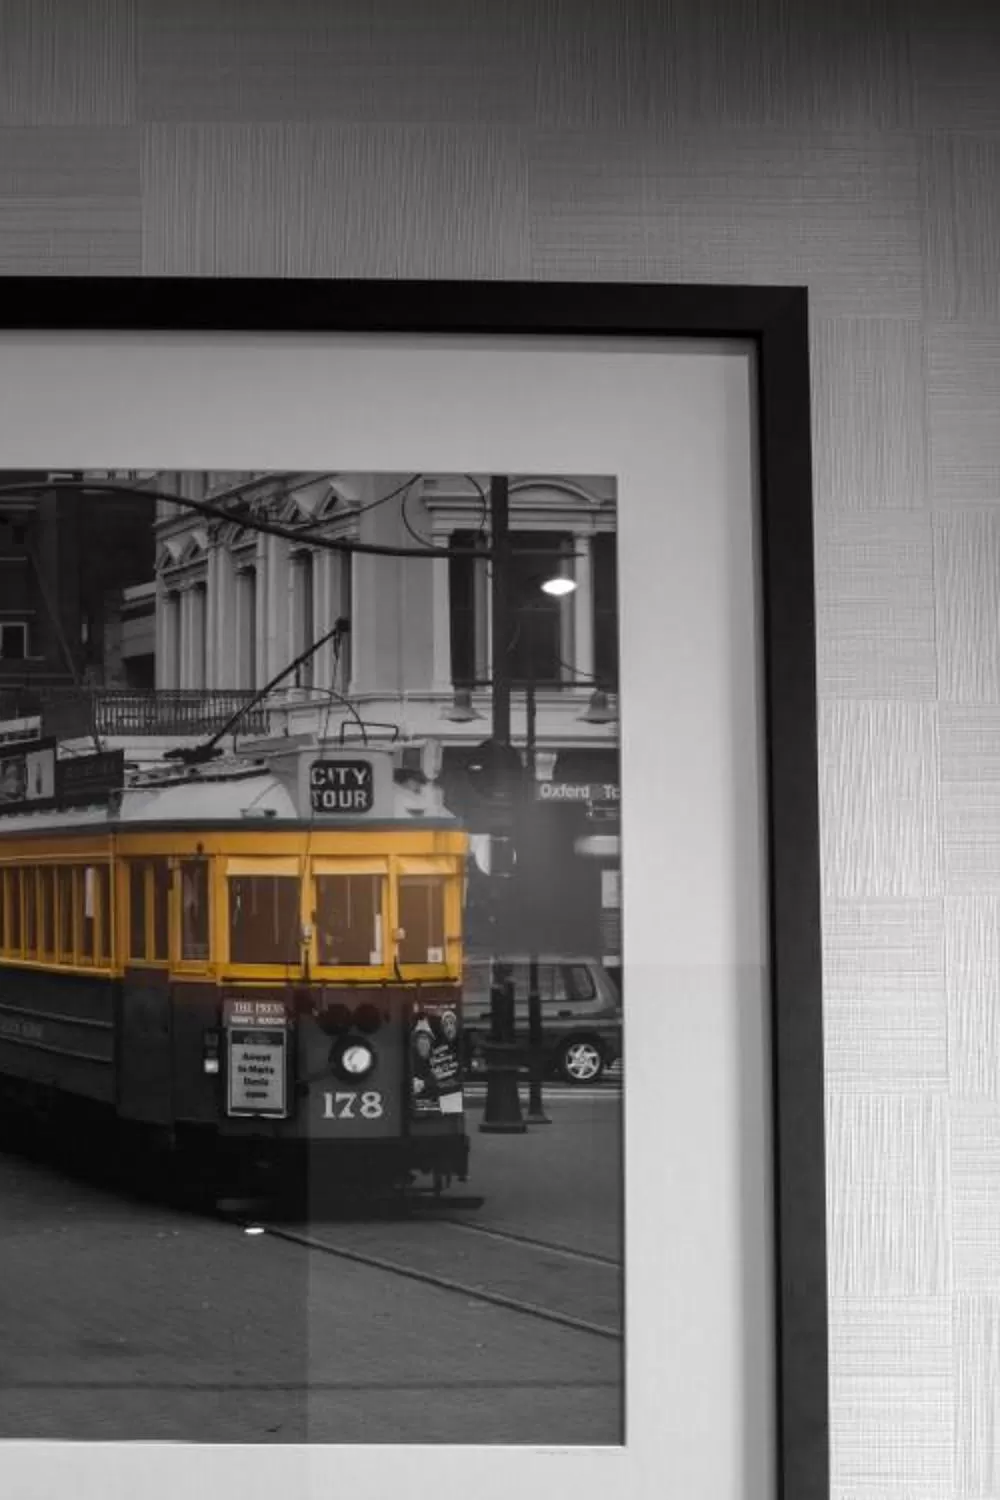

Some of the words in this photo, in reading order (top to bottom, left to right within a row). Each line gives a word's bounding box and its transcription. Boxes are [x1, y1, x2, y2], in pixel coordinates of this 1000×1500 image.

[311, 767, 367, 786] CITY
[311, 790, 368, 809] TOUR
[540, 783, 589, 799] Oxford
[322, 1091, 384, 1119] 178
